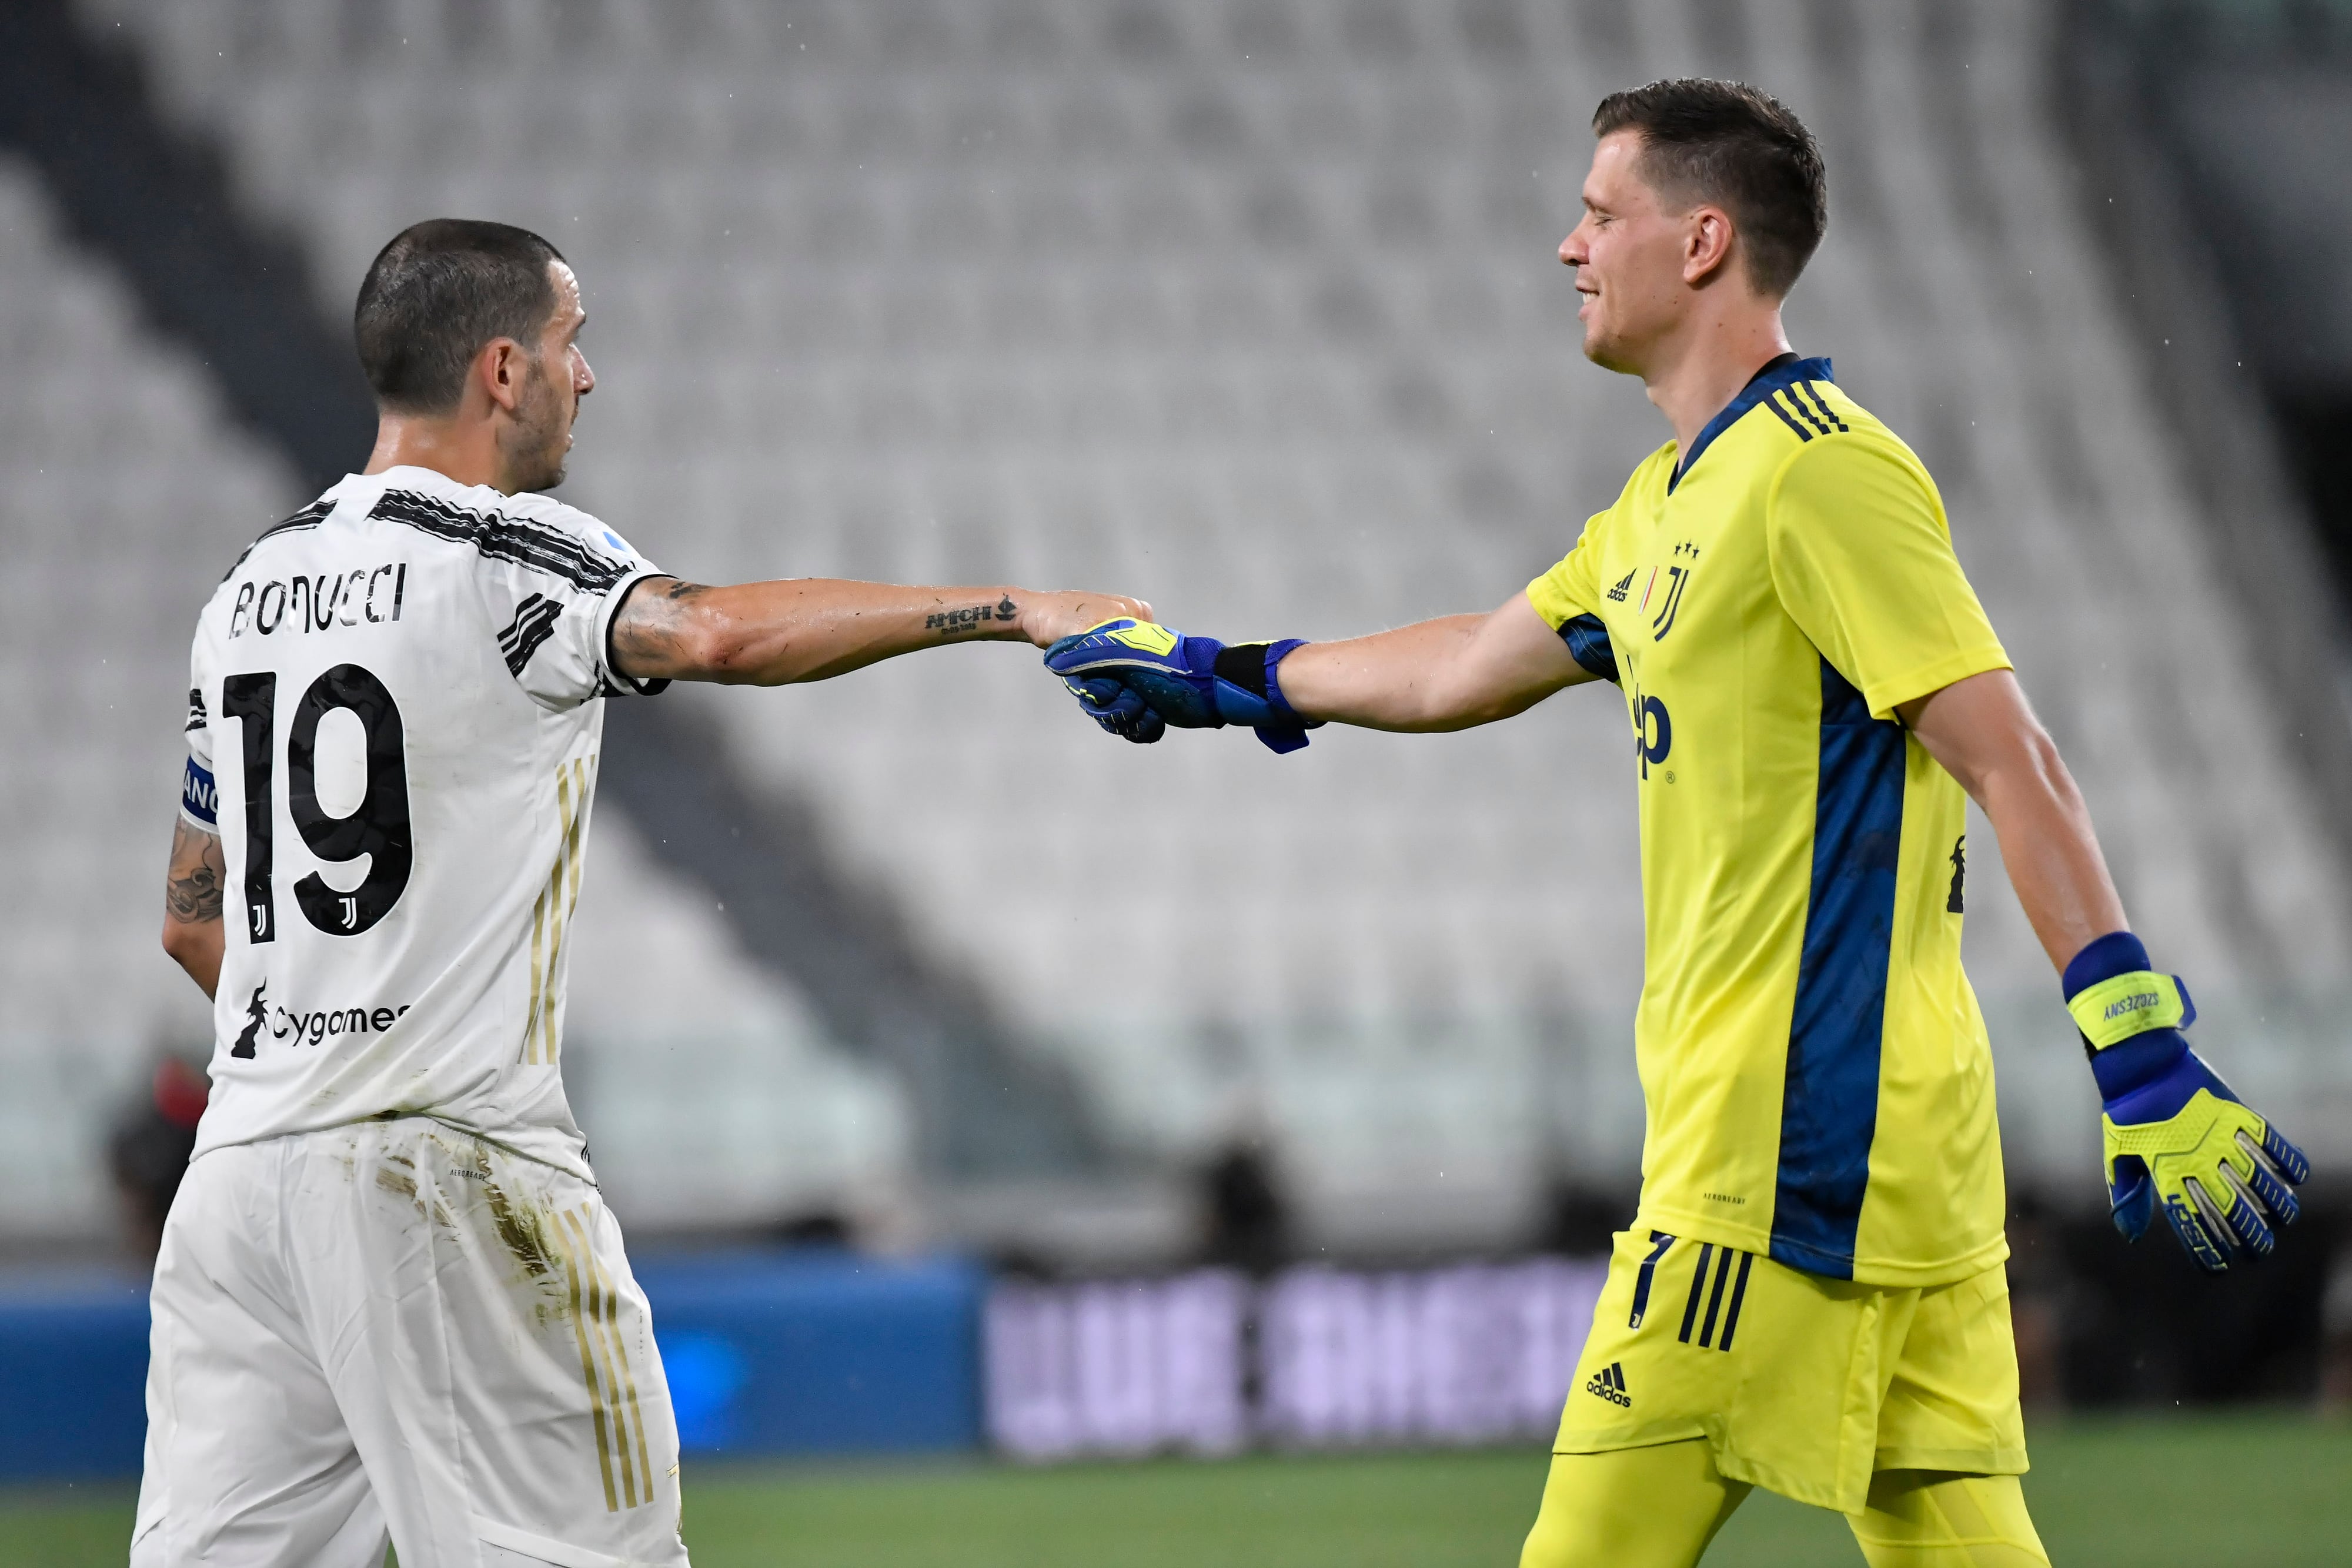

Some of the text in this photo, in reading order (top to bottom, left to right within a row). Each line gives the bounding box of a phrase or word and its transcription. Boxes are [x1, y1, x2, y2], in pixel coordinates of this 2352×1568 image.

[229, 563, 407, 640] BONUCCI
[222, 663, 413, 945] 19
[1586, 1380, 1631, 1407] adidas
